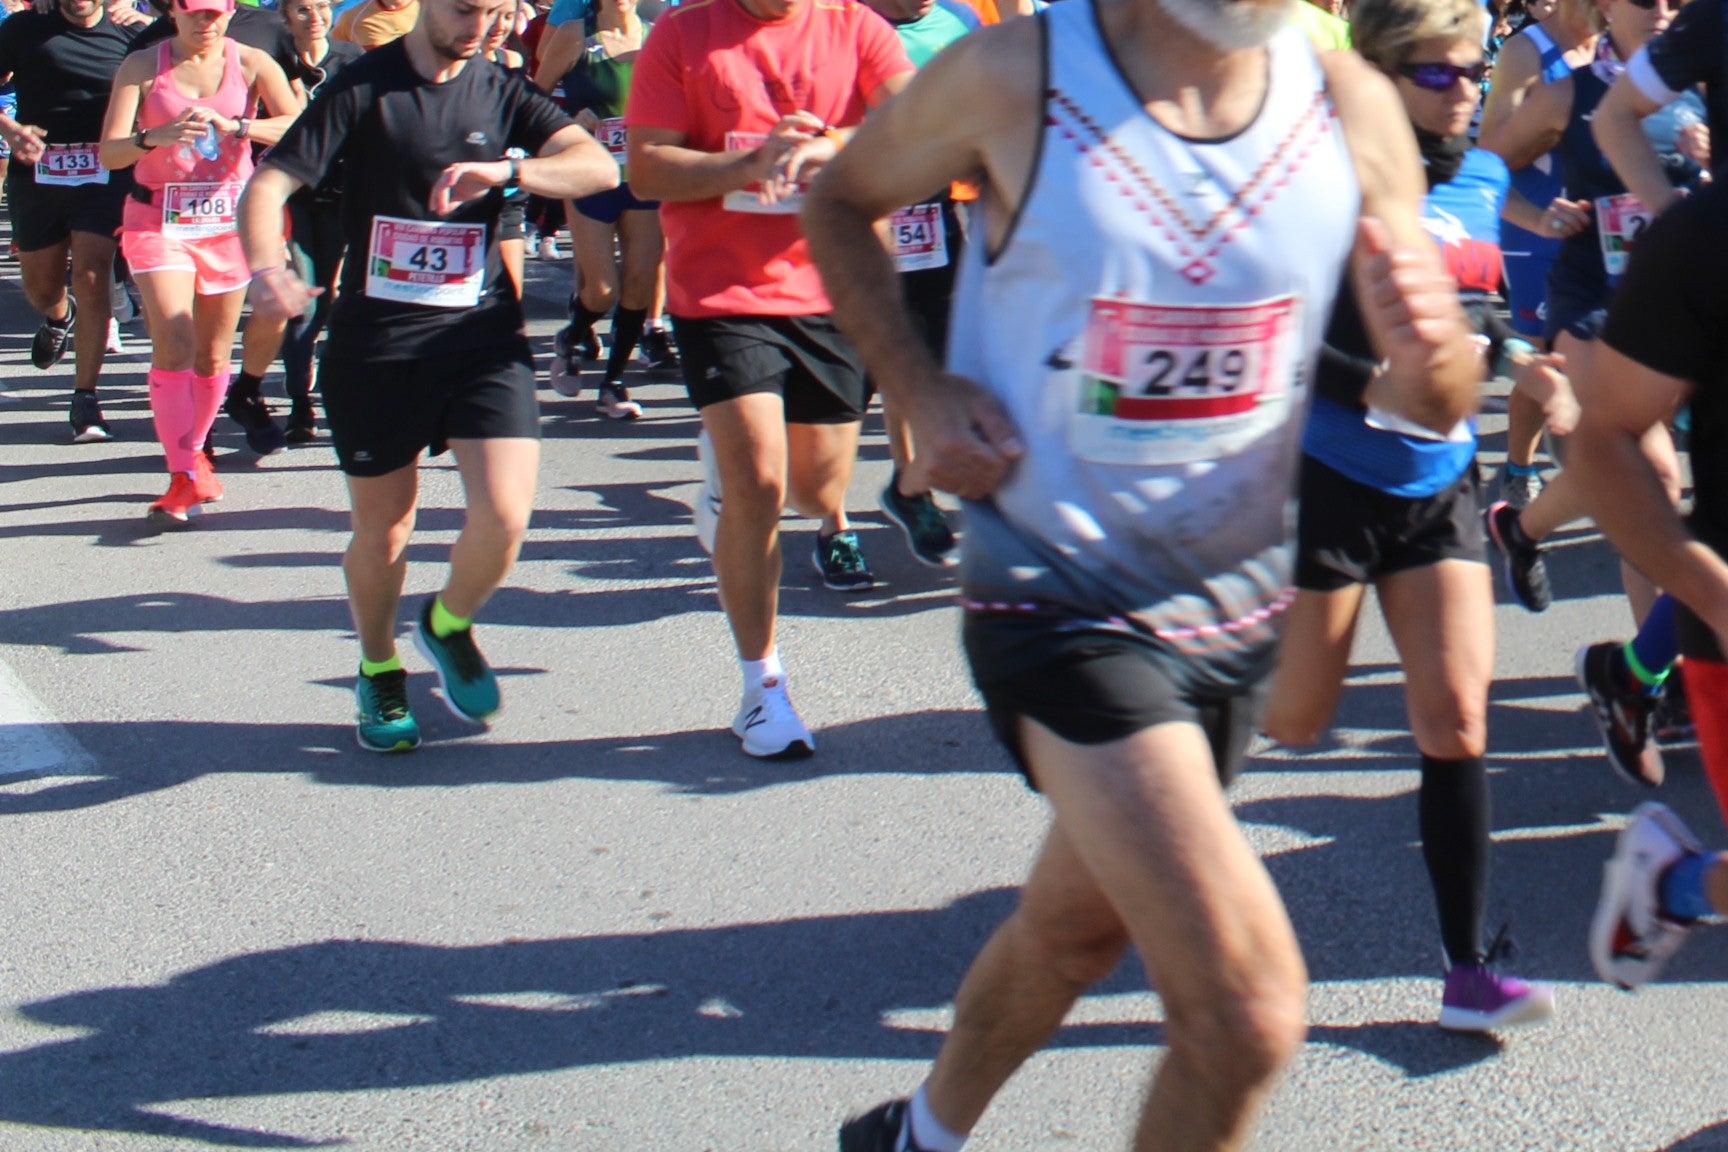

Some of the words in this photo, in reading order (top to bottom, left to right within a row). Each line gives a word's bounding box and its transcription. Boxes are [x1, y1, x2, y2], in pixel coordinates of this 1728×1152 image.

[55, 155, 89, 169] 133
[188, 199, 225, 215] 108
[409, 246, 447, 271] 43
[1143, 349, 1244, 395] 249
